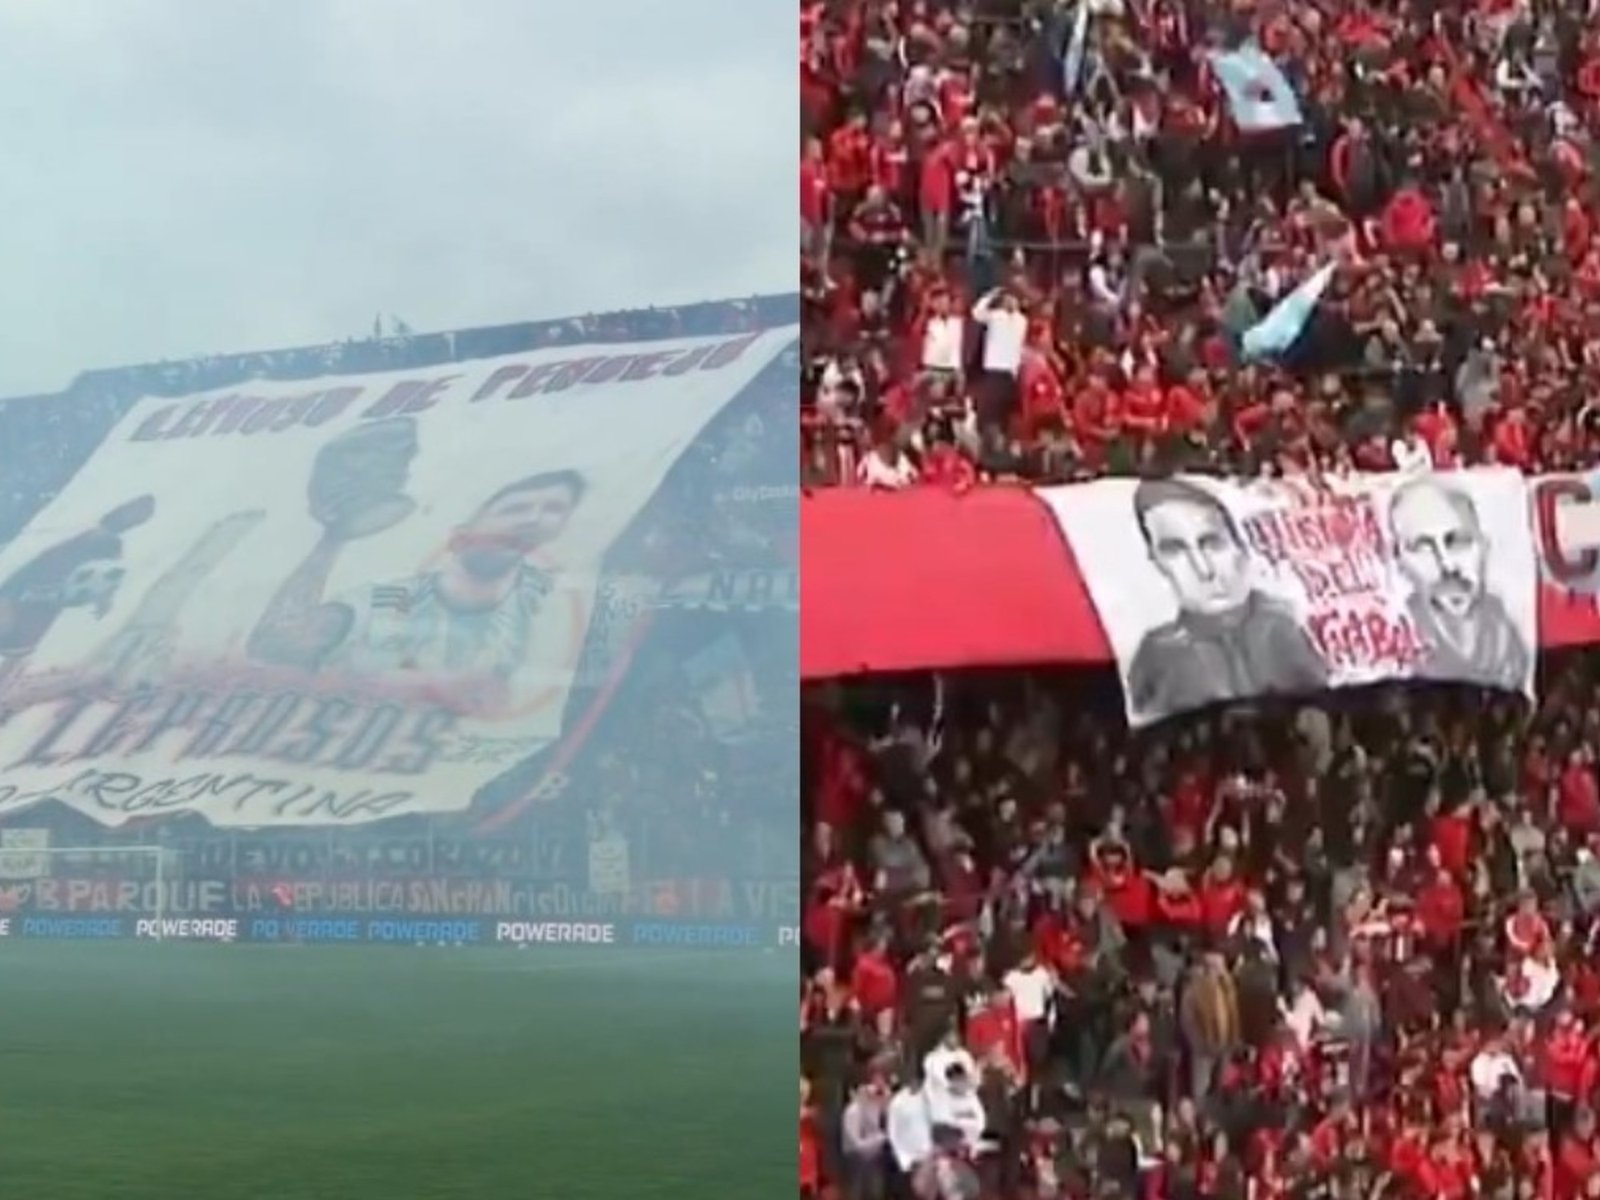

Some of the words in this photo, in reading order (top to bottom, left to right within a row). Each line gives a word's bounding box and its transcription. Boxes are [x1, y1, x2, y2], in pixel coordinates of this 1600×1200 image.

[360, 373, 466, 419] DE
[22, 918, 122, 938] POWERADE
[136, 918, 238, 938] POWERADE
[367, 921, 480, 941] POWERADE
[496, 922, 615, 944] POWERADE
[633, 924, 760, 945] POWERADE
